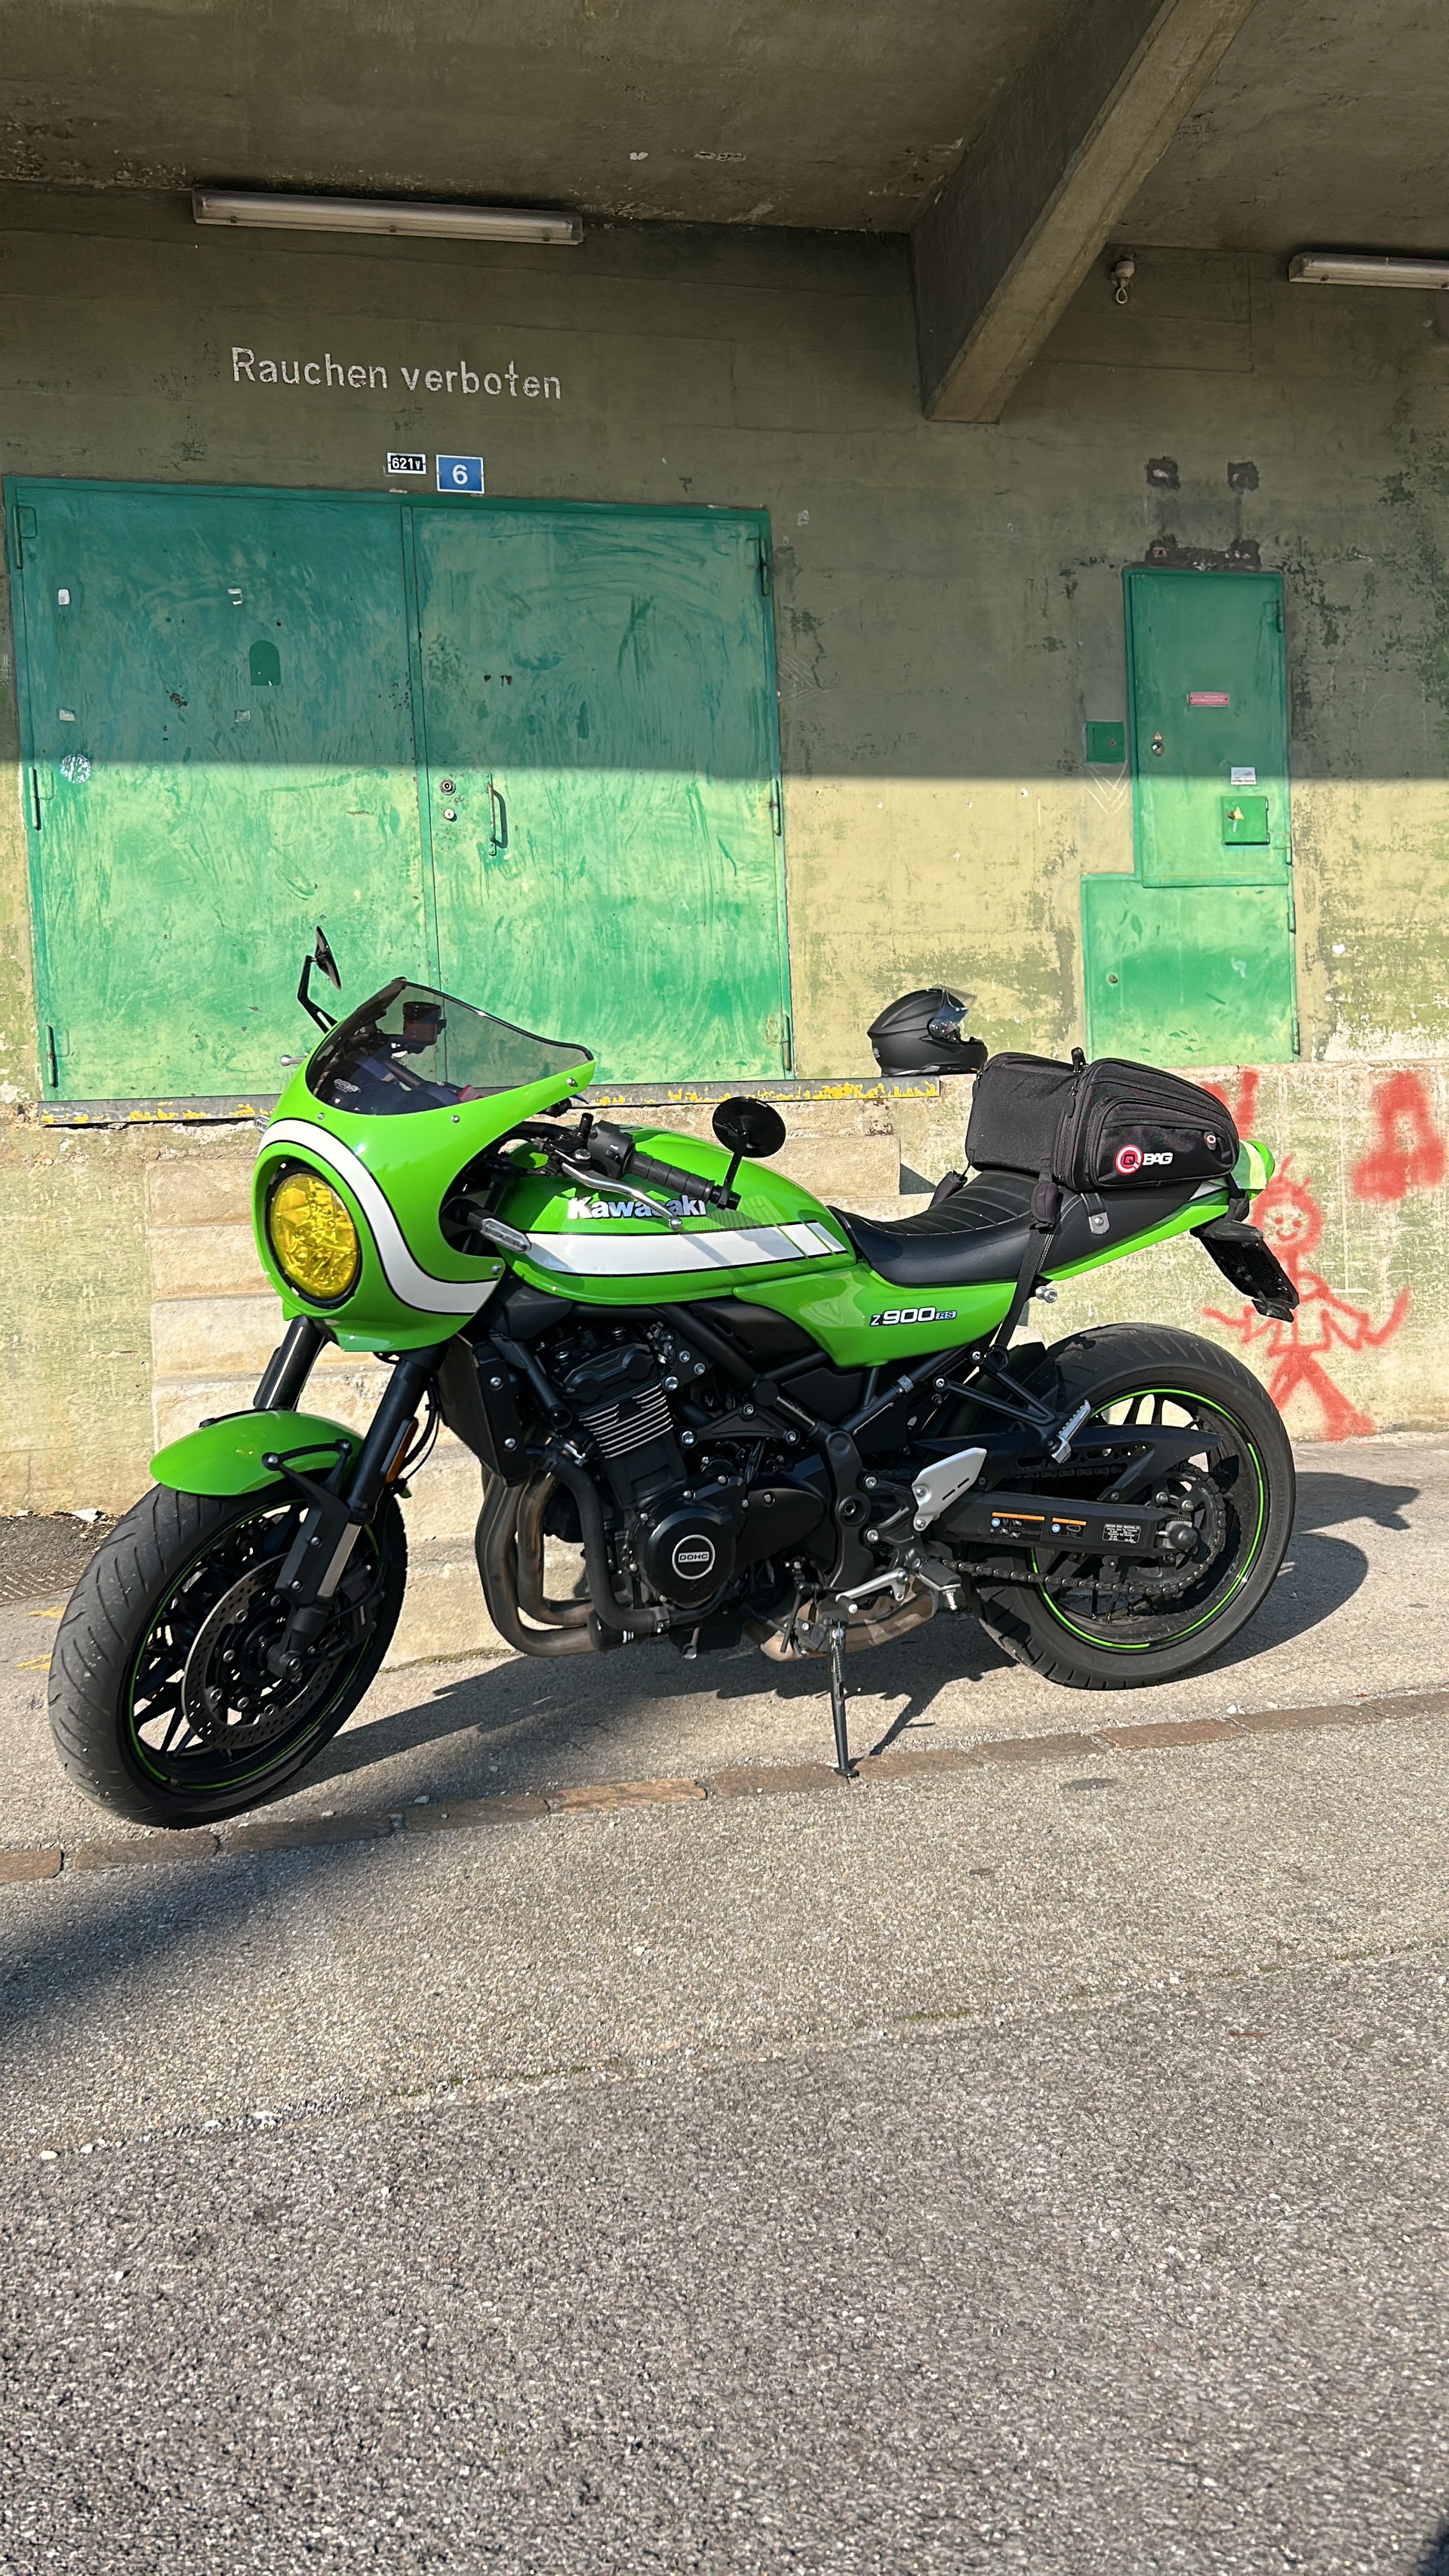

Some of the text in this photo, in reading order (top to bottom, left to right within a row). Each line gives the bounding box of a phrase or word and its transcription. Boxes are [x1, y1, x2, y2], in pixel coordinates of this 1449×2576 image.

[231, 346, 561, 399] Rauchen verboten
[452, 463, 468, 485] 6
[568, 1195, 706, 1220] Kawaaki
[679, 1553, 709, 1561] DOHC
